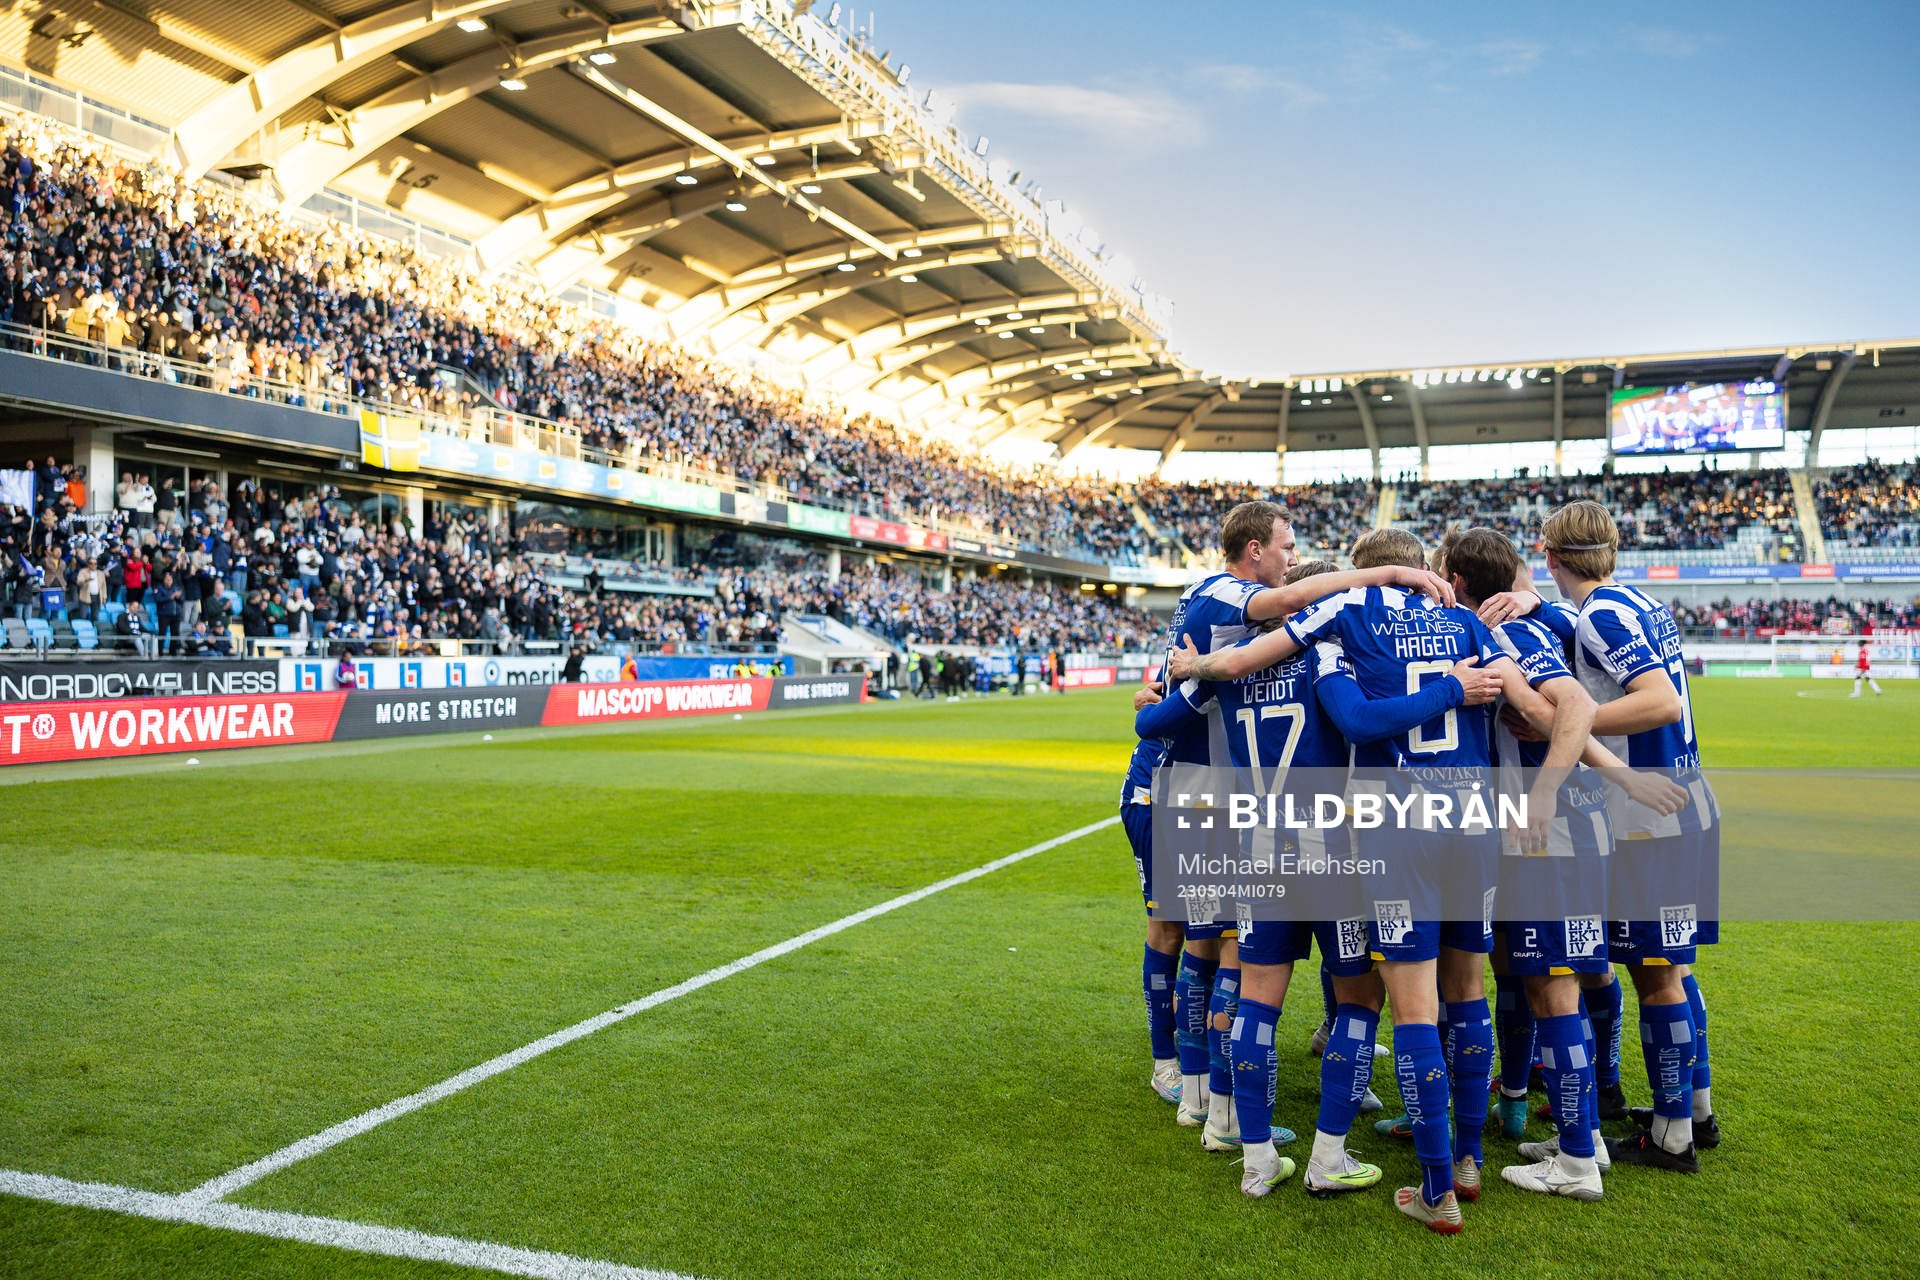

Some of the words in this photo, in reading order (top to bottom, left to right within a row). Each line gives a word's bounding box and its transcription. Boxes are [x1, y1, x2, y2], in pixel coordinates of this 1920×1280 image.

[1371, 621, 1465, 636] WELLNESS
[1395, 635, 1458, 658] HAGEN
[665, 683, 753, 711] WORKWEAR
[1243, 678, 1296, 705] WENDT
[375, 702, 431, 724] MORE
[438, 697, 517, 721] STRETCH
[69, 702, 295, 750] WORKWEAR
[1236, 702, 1307, 798] 17
[1377, 903, 1403, 916] EFF
[1663, 907, 1690, 921] EFF
[1379, 915, 1408, 928] EKT
[1568, 917, 1595, 930] EFF
[1664, 918, 1694, 932] EKT
[1380, 928, 1395, 941] IV
[1525, 927, 1537, 948] 2
[1569, 929, 1600, 942] EKT
[1665, 931, 1682, 944] IV
[1342, 943, 1359, 956] IV
[1569, 942, 1586, 954] IV
